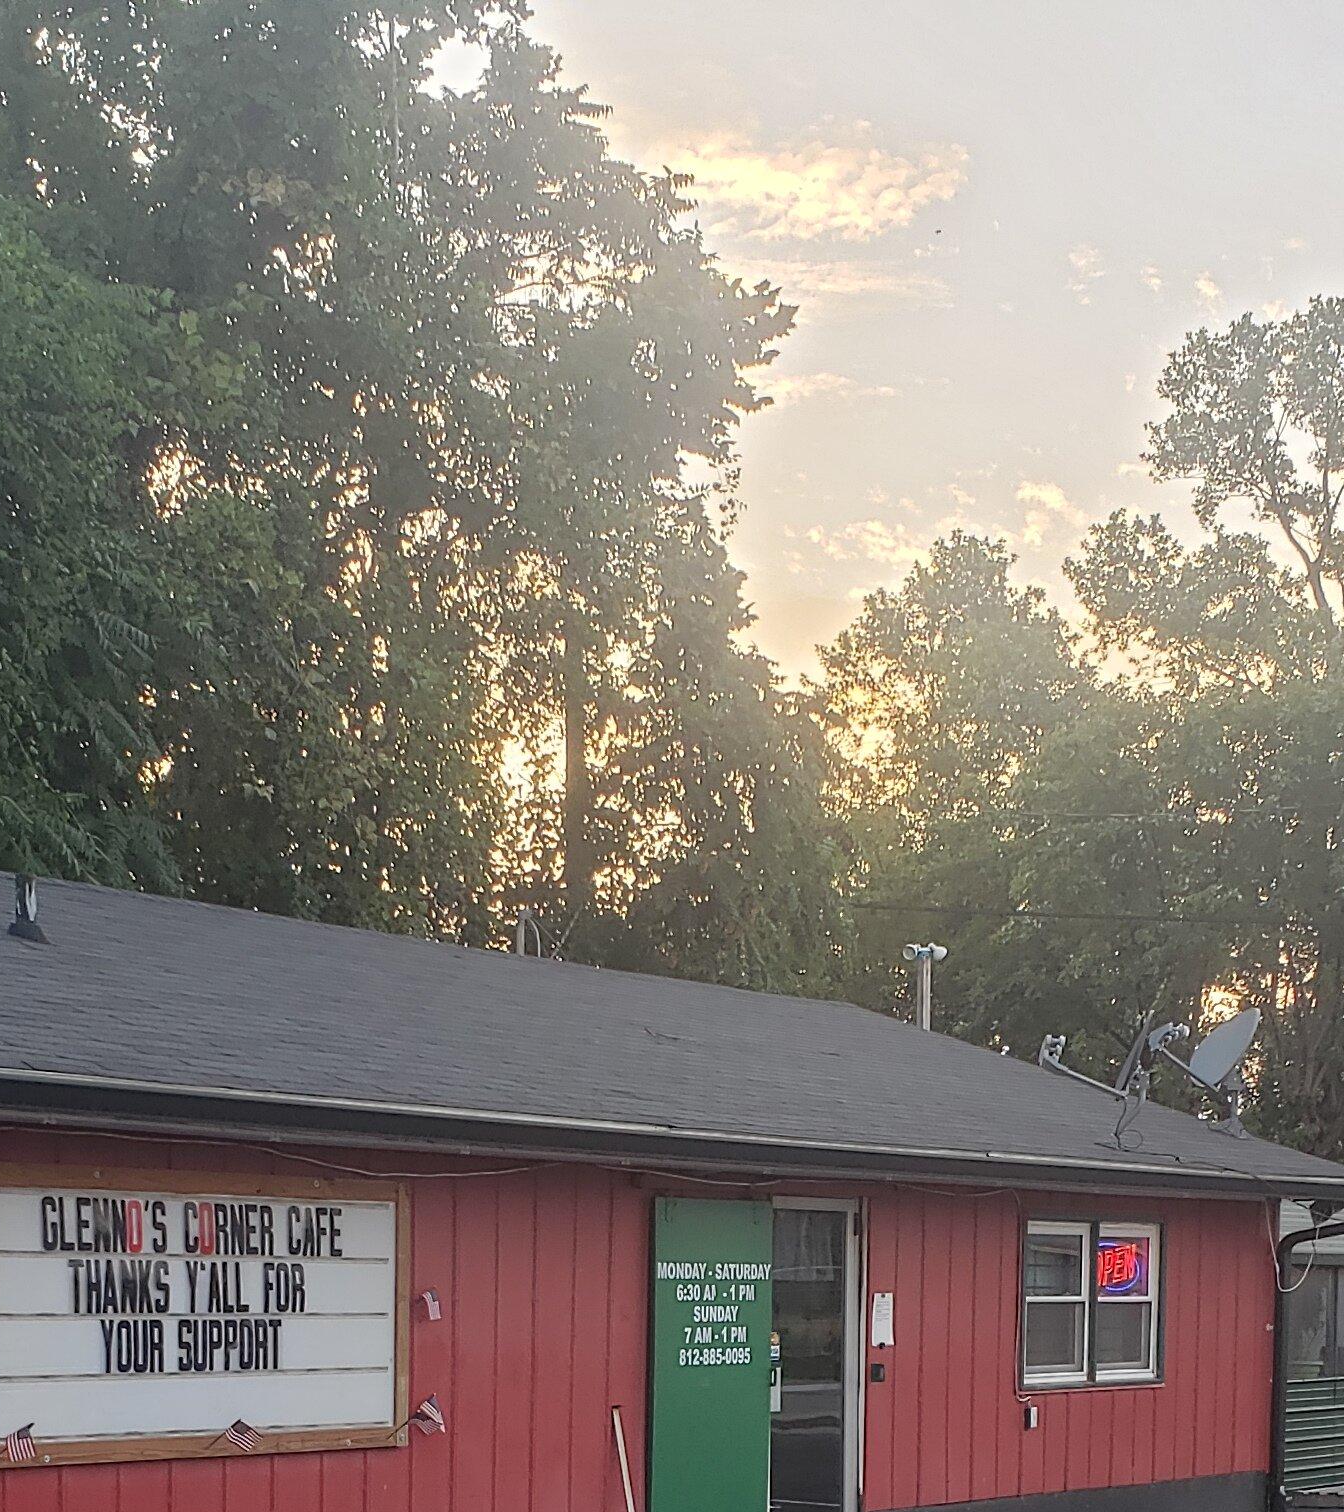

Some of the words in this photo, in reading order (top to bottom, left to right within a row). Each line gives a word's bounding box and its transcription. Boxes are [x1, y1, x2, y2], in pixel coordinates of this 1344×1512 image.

[41, 1196, 168, 1254] GLENNO'S
[184, 1201, 274, 1256] CORNER
[287, 1205, 343, 1257] CAFE
[657, 1262, 707, 1280] MONDAY
[715, 1263, 772, 1280] SATURDAY
[68, 1258, 170, 1314] THANKS
[185, 1260, 250, 1314] Y'ALL
[263, 1262, 306, 1314] FOR
[676, 1284, 701, 1302] 6:30
[729, 1284, 736, 1301] 1
[738, 1284, 755, 1302] PM
[693, 1305, 739, 1323] SUNDAY
[684, 1327, 692, 1344] 7
[694, 1327, 712, 1344] AM
[721, 1326, 728, 1343] 1
[730, 1326, 747, 1343] PM
[100, 1318, 165, 1374] YOUR
[178, 1318, 282, 1372] SUPPORT
[679, 1347, 751, 1366] 812-885-0095
